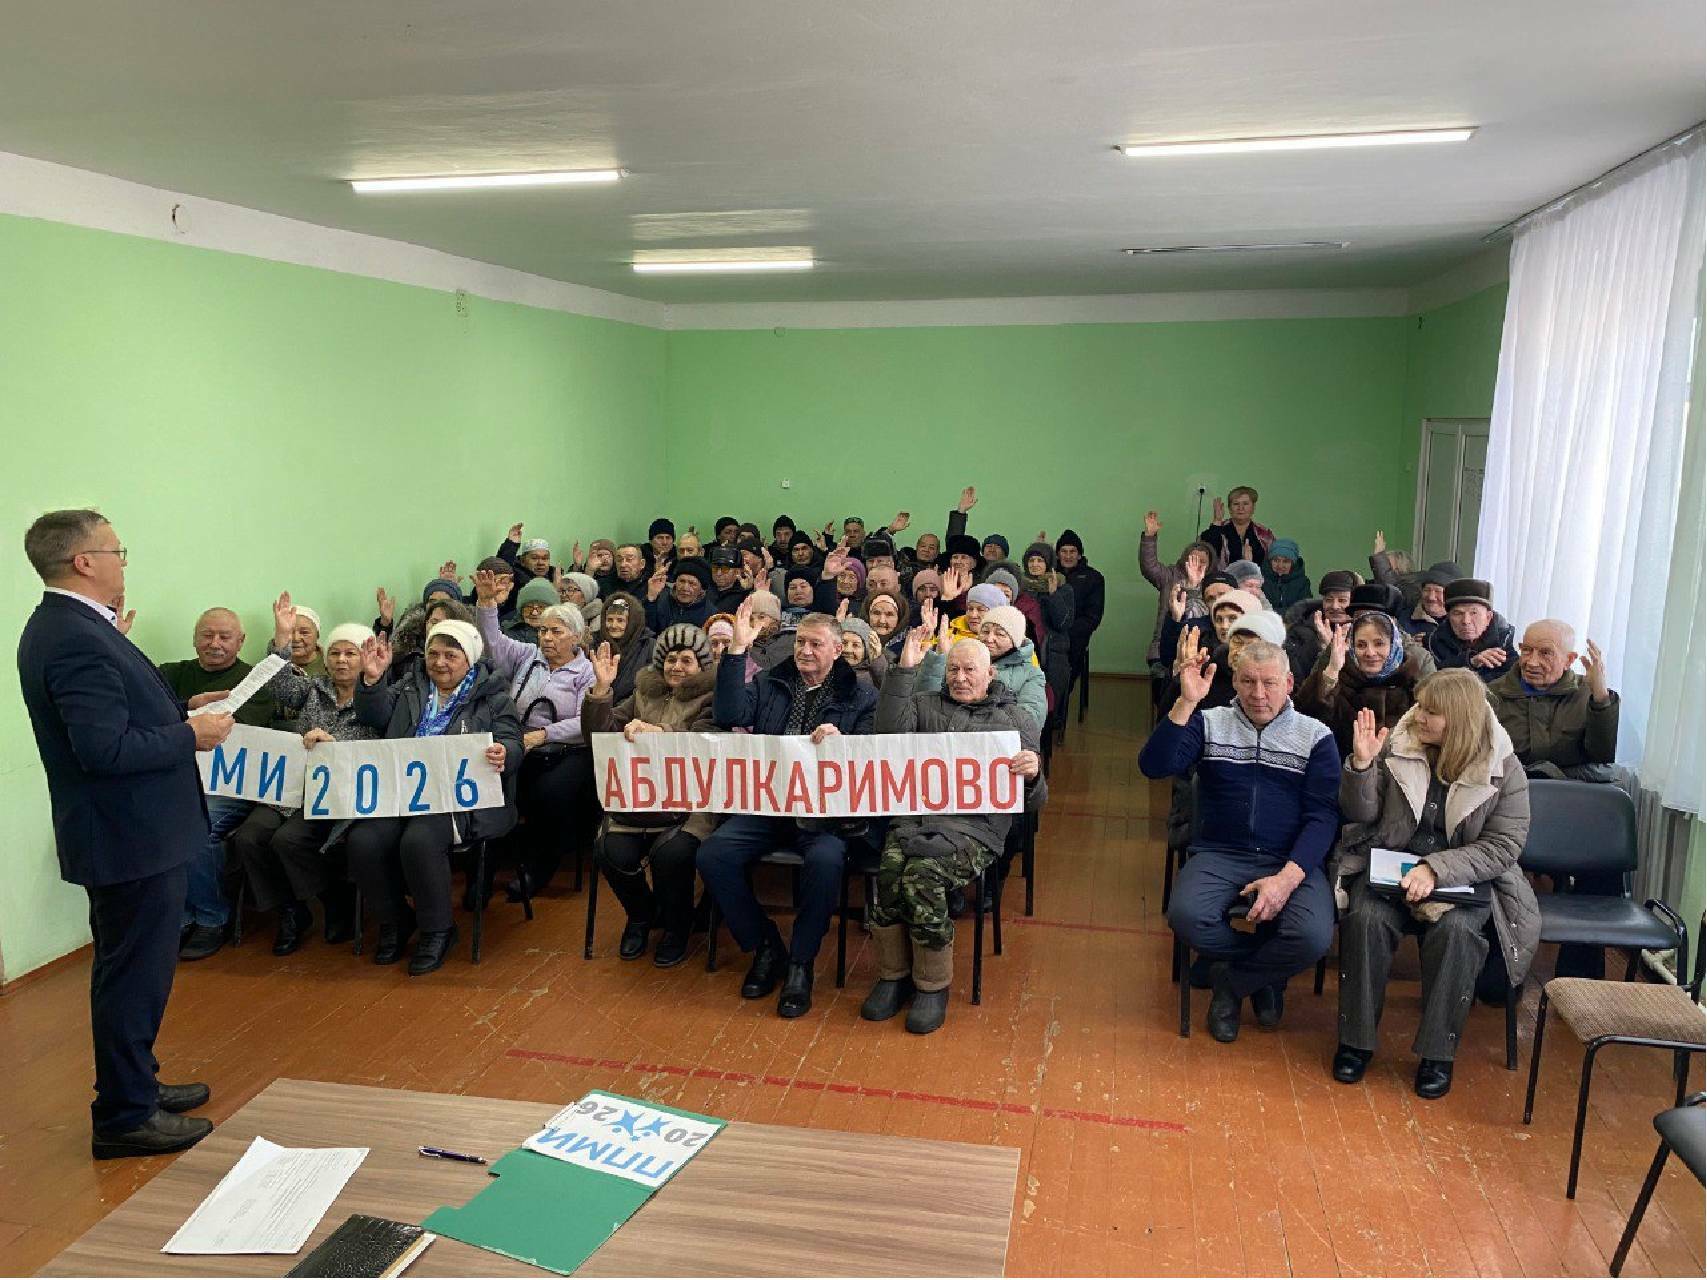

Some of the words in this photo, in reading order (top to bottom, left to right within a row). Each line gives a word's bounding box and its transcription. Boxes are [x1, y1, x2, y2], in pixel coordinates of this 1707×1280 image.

[311, 758, 480, 816] 2026
[604, 756, 1018, 814] АБДУЛКАРИМОВО
[575, 1101, 618, 1122] 26
[663, 1128, 709, 1147] 20
[536, 1126, 674, 1179] ППМИ
